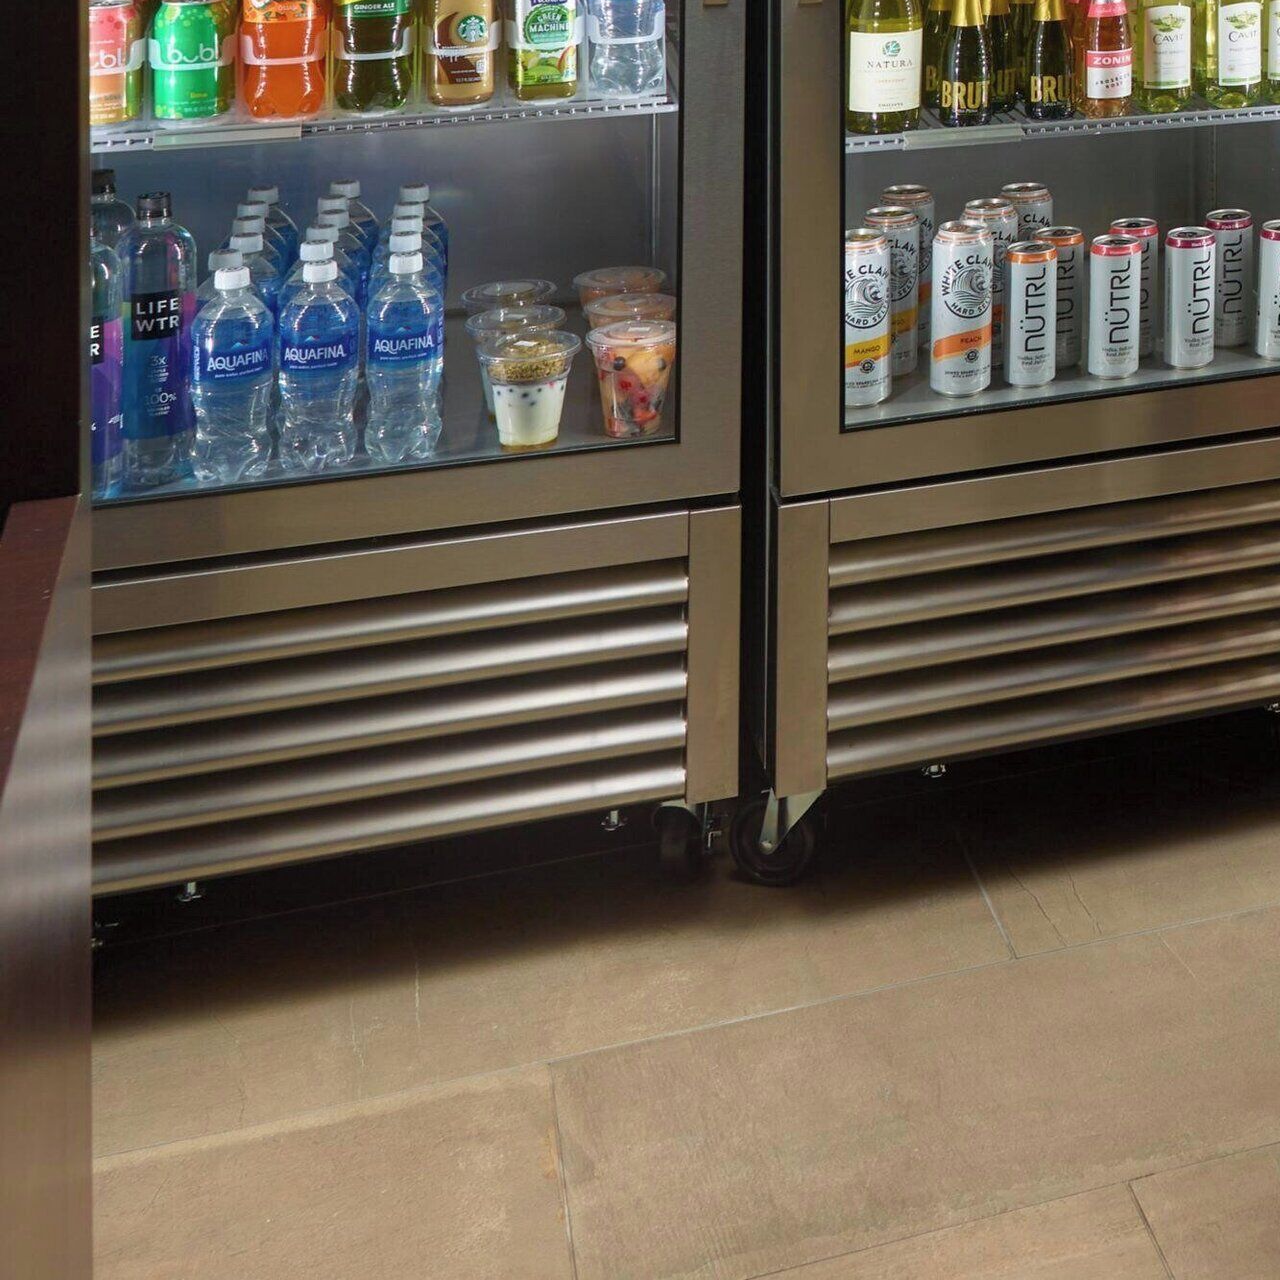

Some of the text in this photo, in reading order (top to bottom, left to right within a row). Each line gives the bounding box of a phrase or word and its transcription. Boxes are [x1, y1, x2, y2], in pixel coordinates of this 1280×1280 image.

[529, 23, 569, 32] MACHINE
[1153, 34, 1183, 45] CAVIT
[1229, 30, 1257, 42] CAVIT
[867, 59, 912, 69] NATURA
[1093, 55, 1131, 65] ZONIN
[942, 80, 990, 109] BRUT
[858, 264, 889, 279] CLAW
[942, 255, 993, 296] WHITE CLAW
[135, 298, 179, 316] LIFE
[951, 302, 975, 316] HARD
[134, 315, 180, 332] WTR
[374, 335, 434, 354] AQUAFINA
[960, 335, 982, 344] PEACH
[284, 344, 345, 364] AQUAFINA
[853, 345, 881, 354] MANGO
[207, 350, 268, 373] AQUAFINA
